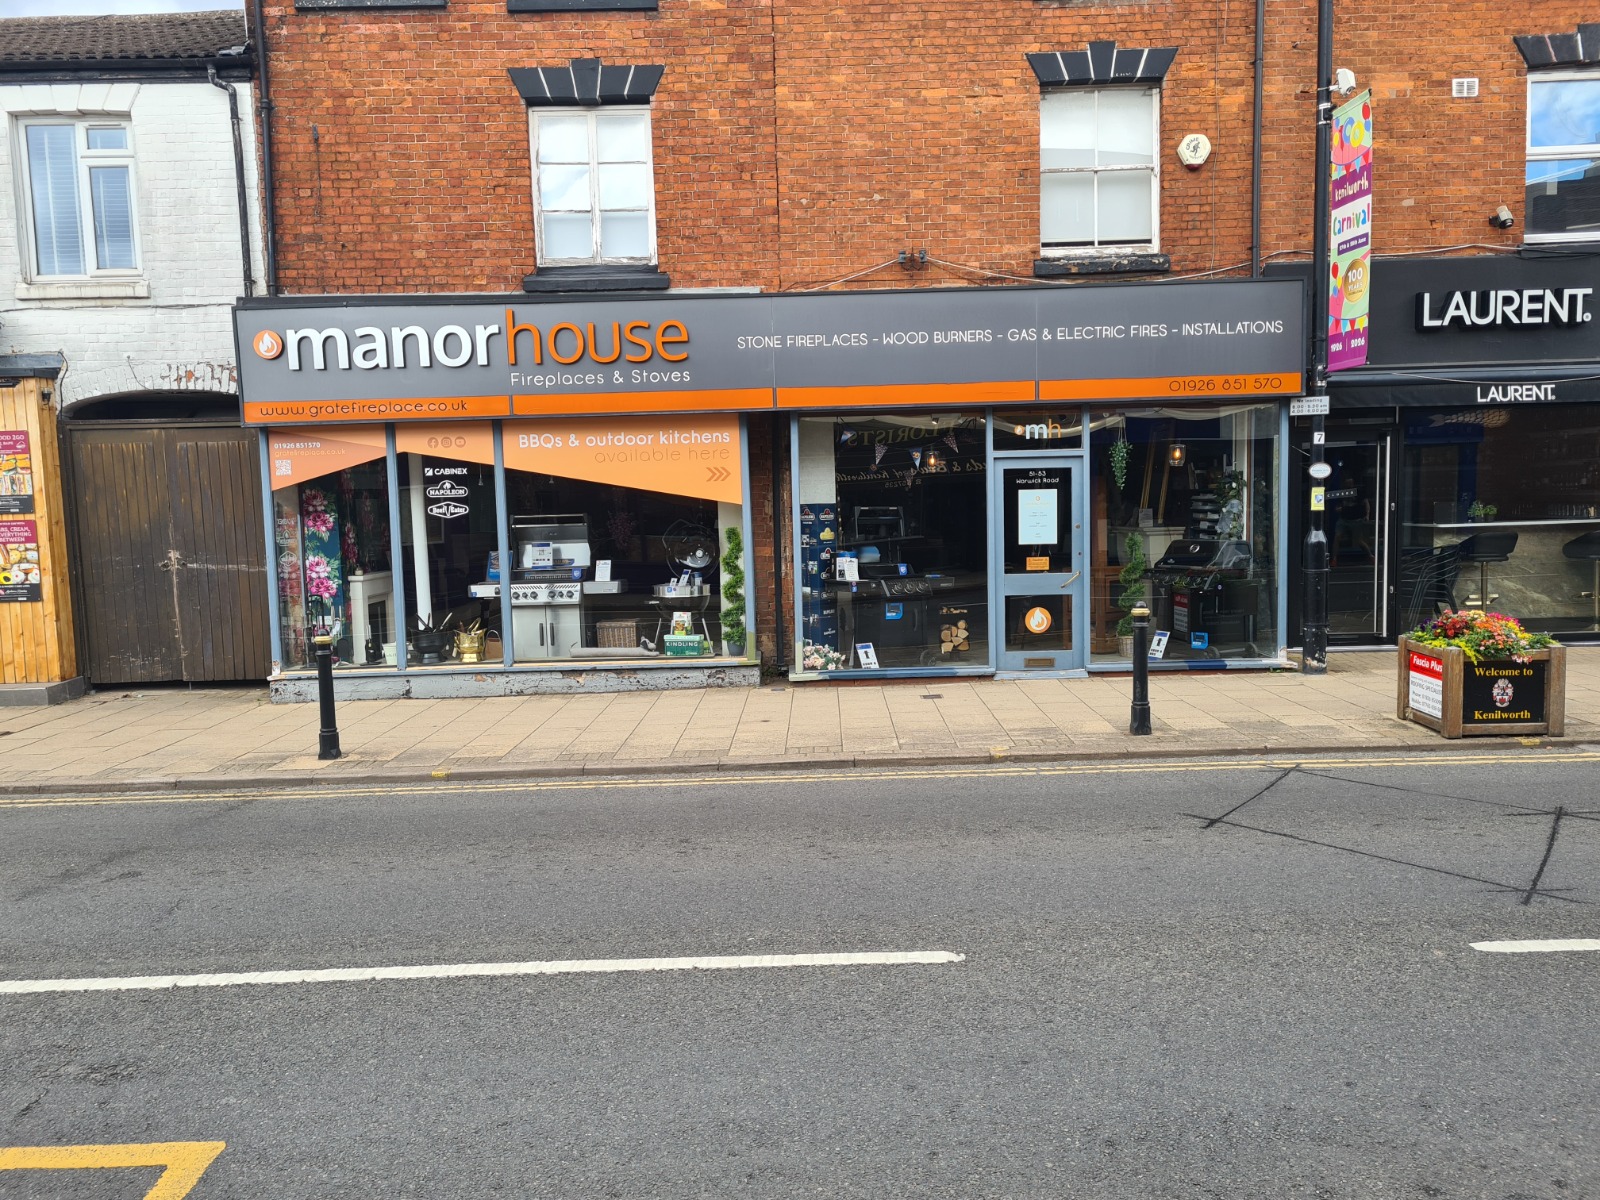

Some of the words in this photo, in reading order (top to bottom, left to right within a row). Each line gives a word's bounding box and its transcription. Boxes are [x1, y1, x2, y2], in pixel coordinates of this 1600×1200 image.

[1333, 203, 1370, 236] Carnival
[1348, 267, 1363, 283] 100
[737, 335, 782, 349] STONE
[787, 333, 868, 348] FIREPLACES
[883, 331, 929, 345] WOOD
[933, 329, 993, 344] BURNERS
[1007, 328, 1037, 342] GAS
[1042, 328, 1052, 340] &
[1057, 325, 1126, 340] ELECTRIC
[1130, 324, 1168, 338] FIRES
[1182, 320, 1284, 336] INSTALLATIONS
[1330, 341, 1343, 352] 1926
[1350, 336, 1365, 348] 2026
[510, 371, 604, 388] Fireplaces
[613, 370, 624, 384] &
[632, 369, 691, 384] Stoves
[1169, 379, 1215, 392] 01926
[1222, 378, 1247, 391] 851
[1253, 377, 1282, 390] 570
[260, 399, 467, 417] www.gratefireplace.co.uk
[1025, 418, 1062, 440] mh
[295, 441, 321, 449] 851570
[519, 433, 562, 449] BBQs
[568, 433, 580, 447] &
[585, 431, 653, 447] outdoor
[659, 430, 730, 445] kitchens
[1317, 433, 1324, 442] 7
[594, 448, 681, 463] available
[688, 446, 730, 461] here
[434, 467, 468, 475] CABINEX
[1412, 655, 1430, 668] Fascia
[1430, 660, 1443, 673] Plus
[1474, 667, 1520, 677] Welcome
[1523, 667, 1533, 676] to
[1474, 710, 1531, 720] Kenilworth
